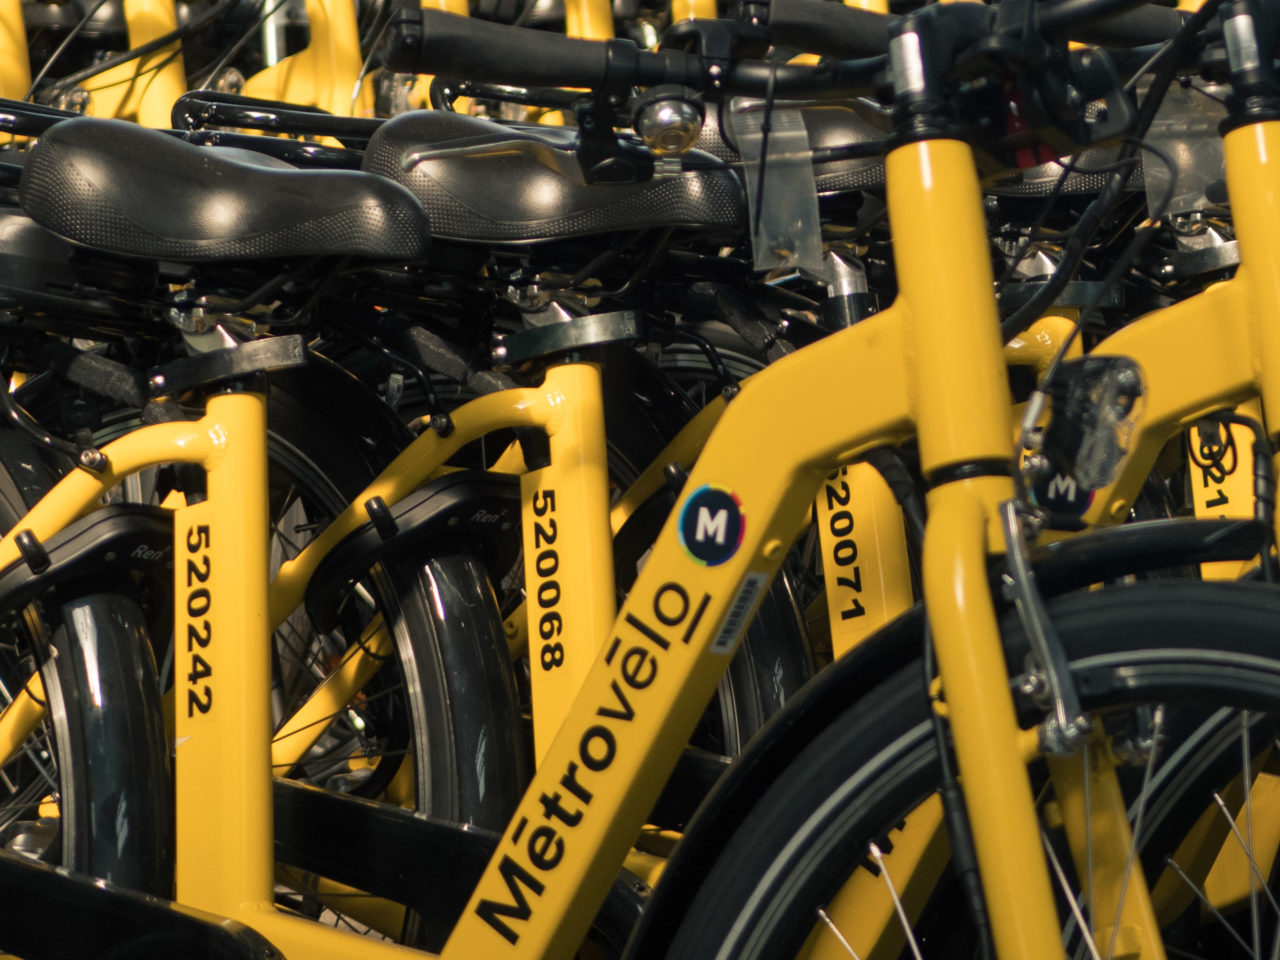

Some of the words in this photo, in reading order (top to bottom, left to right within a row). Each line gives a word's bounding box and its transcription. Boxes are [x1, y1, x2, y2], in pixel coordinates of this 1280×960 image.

[695, 506, 728, 545] M
[1048, 473, 1076, 501] M
[186, 525, 212, 718] 520242
[533, 490, 564, 671] 520068
